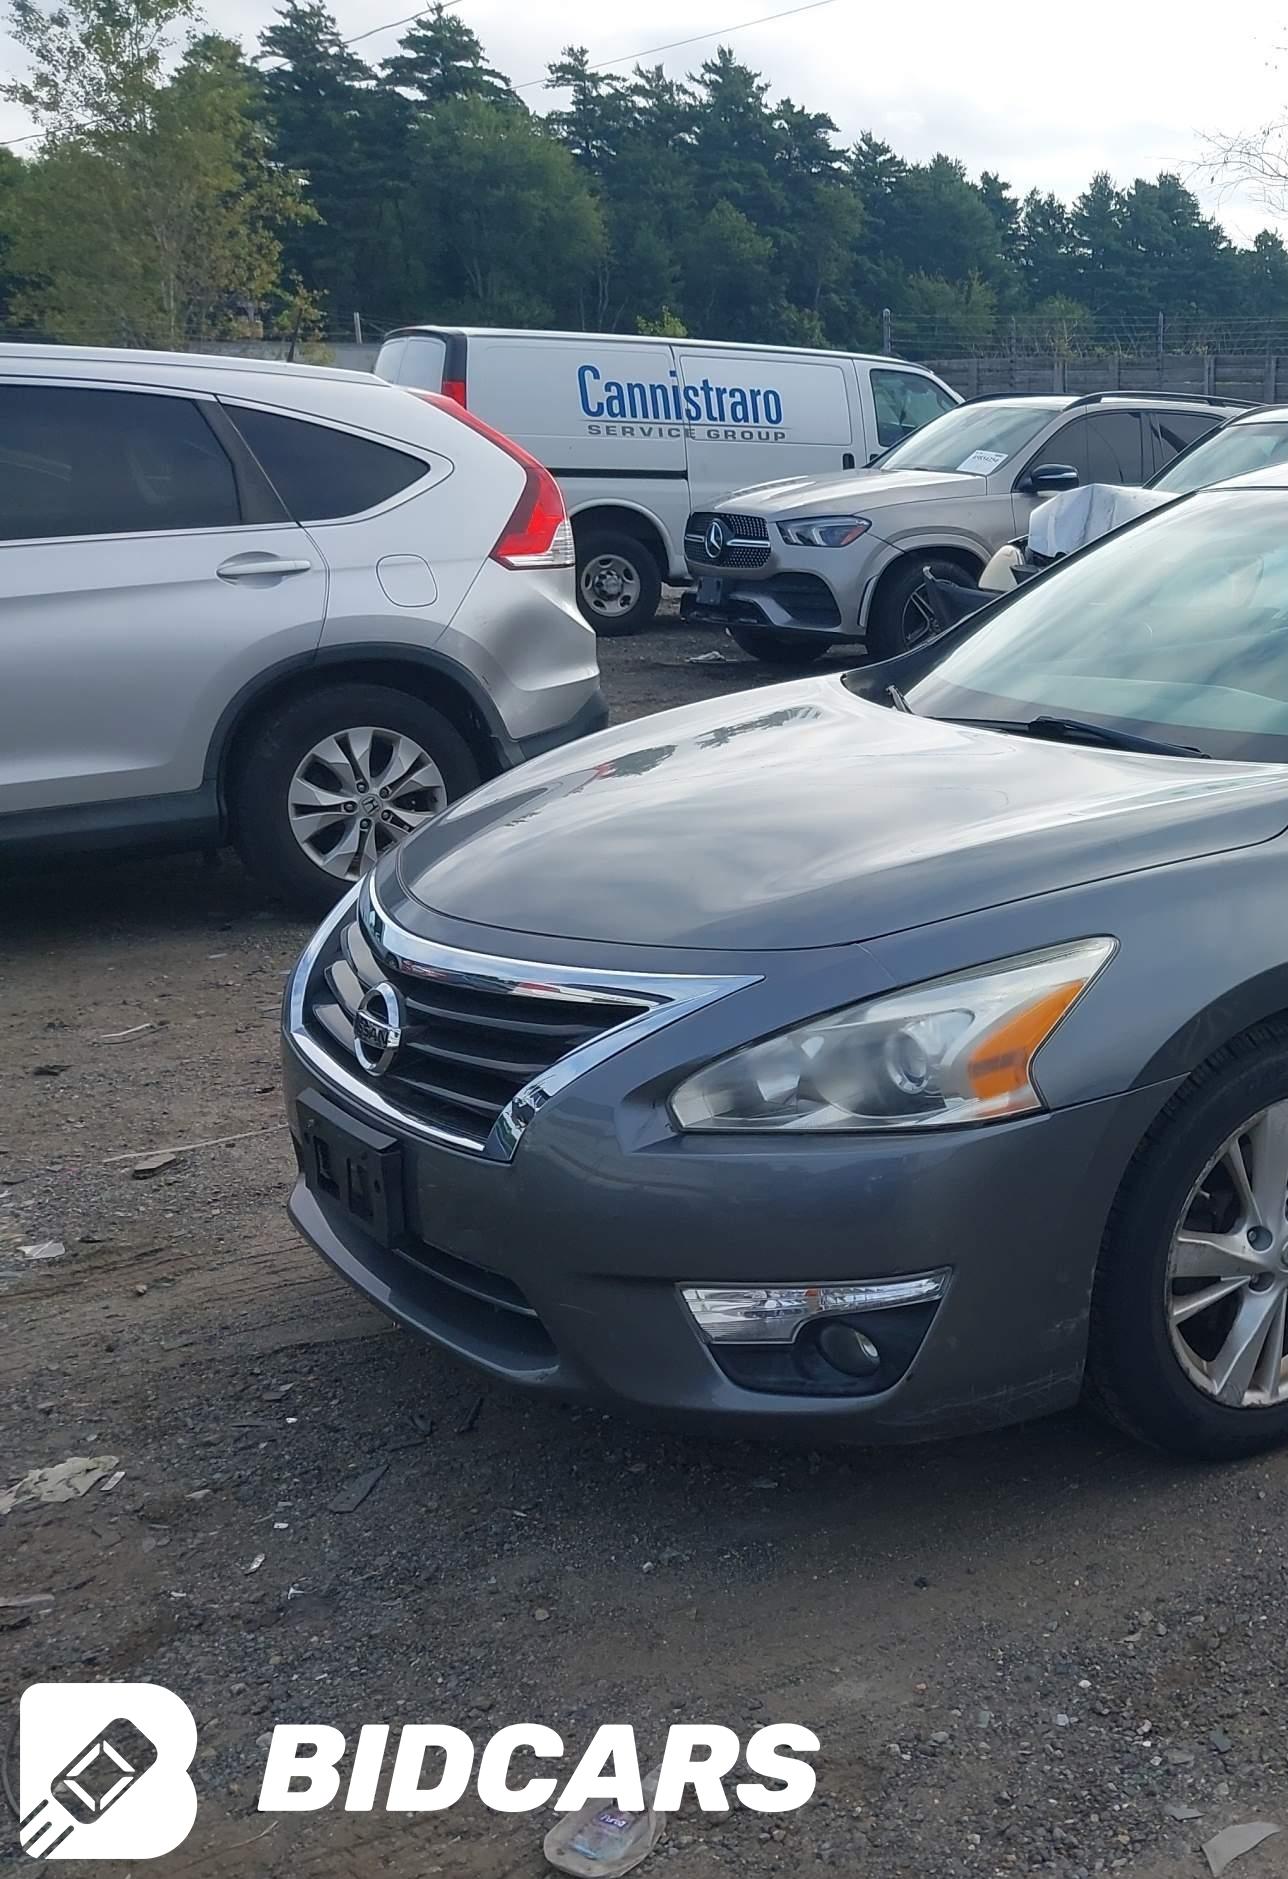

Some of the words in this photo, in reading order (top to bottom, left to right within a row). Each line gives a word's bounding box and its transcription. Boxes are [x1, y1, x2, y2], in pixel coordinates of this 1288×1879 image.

[577, 365, 783, 425] Cannistraro
[588, 424, 697, 440] SERVICE
[706, 428, 786, 441] GROUP
